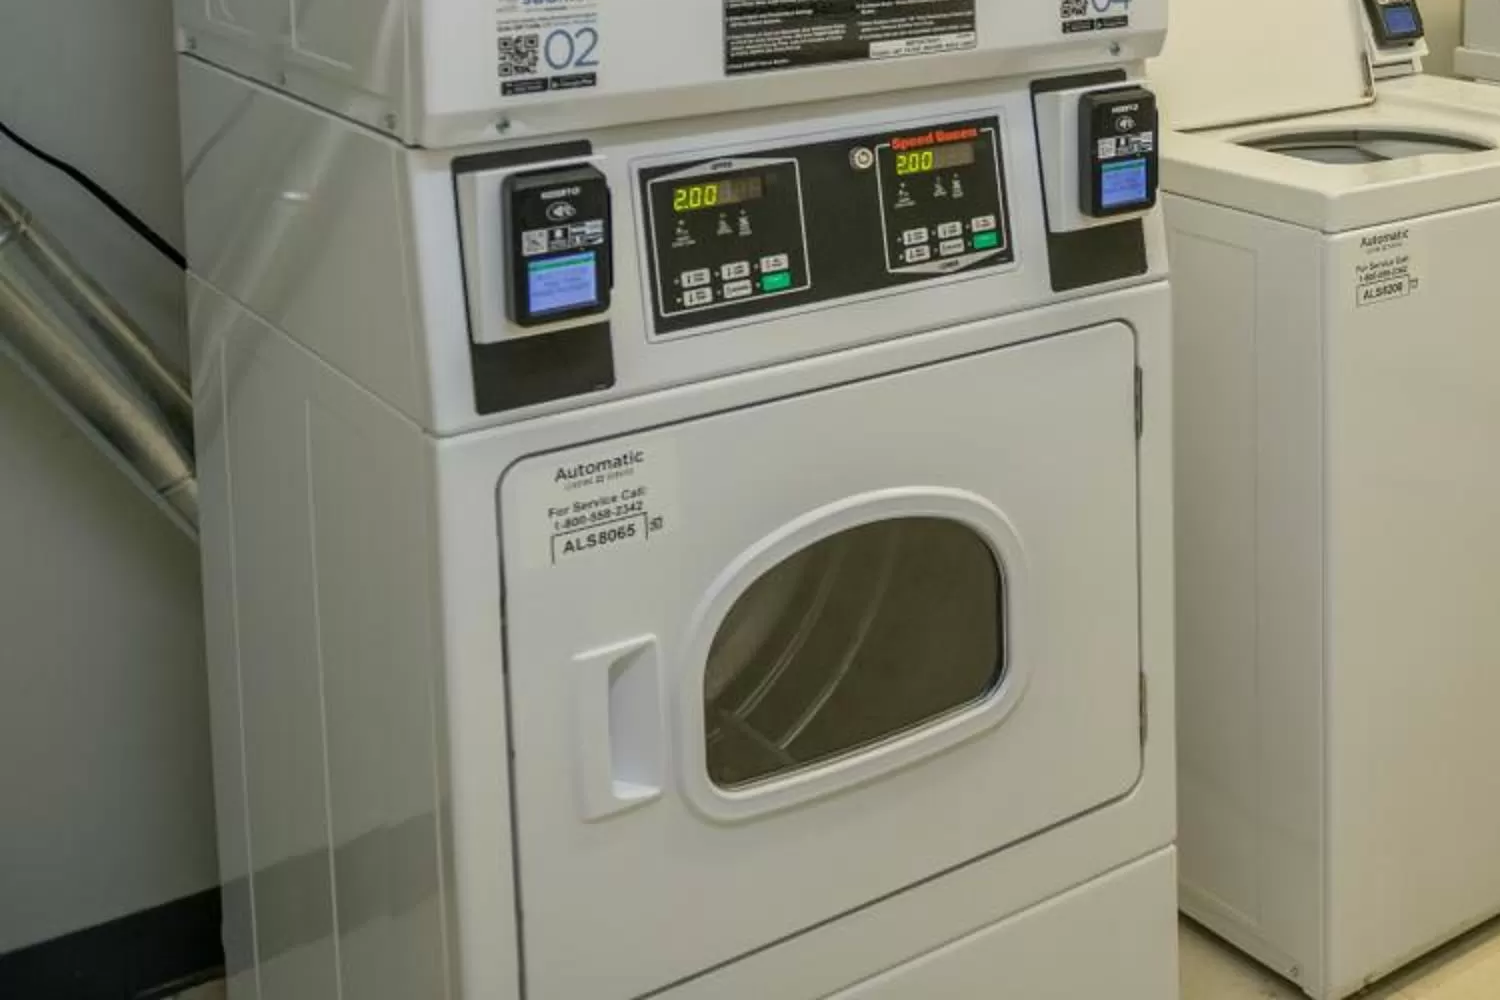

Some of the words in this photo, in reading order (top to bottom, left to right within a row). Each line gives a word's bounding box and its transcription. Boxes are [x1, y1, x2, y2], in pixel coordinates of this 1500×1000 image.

[544, 27, 600, 70] 02
[890, 132, 934, 151] Speed
[935, 127, 978, 143] Queen
[554, 450, 644, 483] Automatic
[548, 506, 569, 519] For
[572, 495, 618, 513] Service
[563, 523, 636, 554] ALS8065
